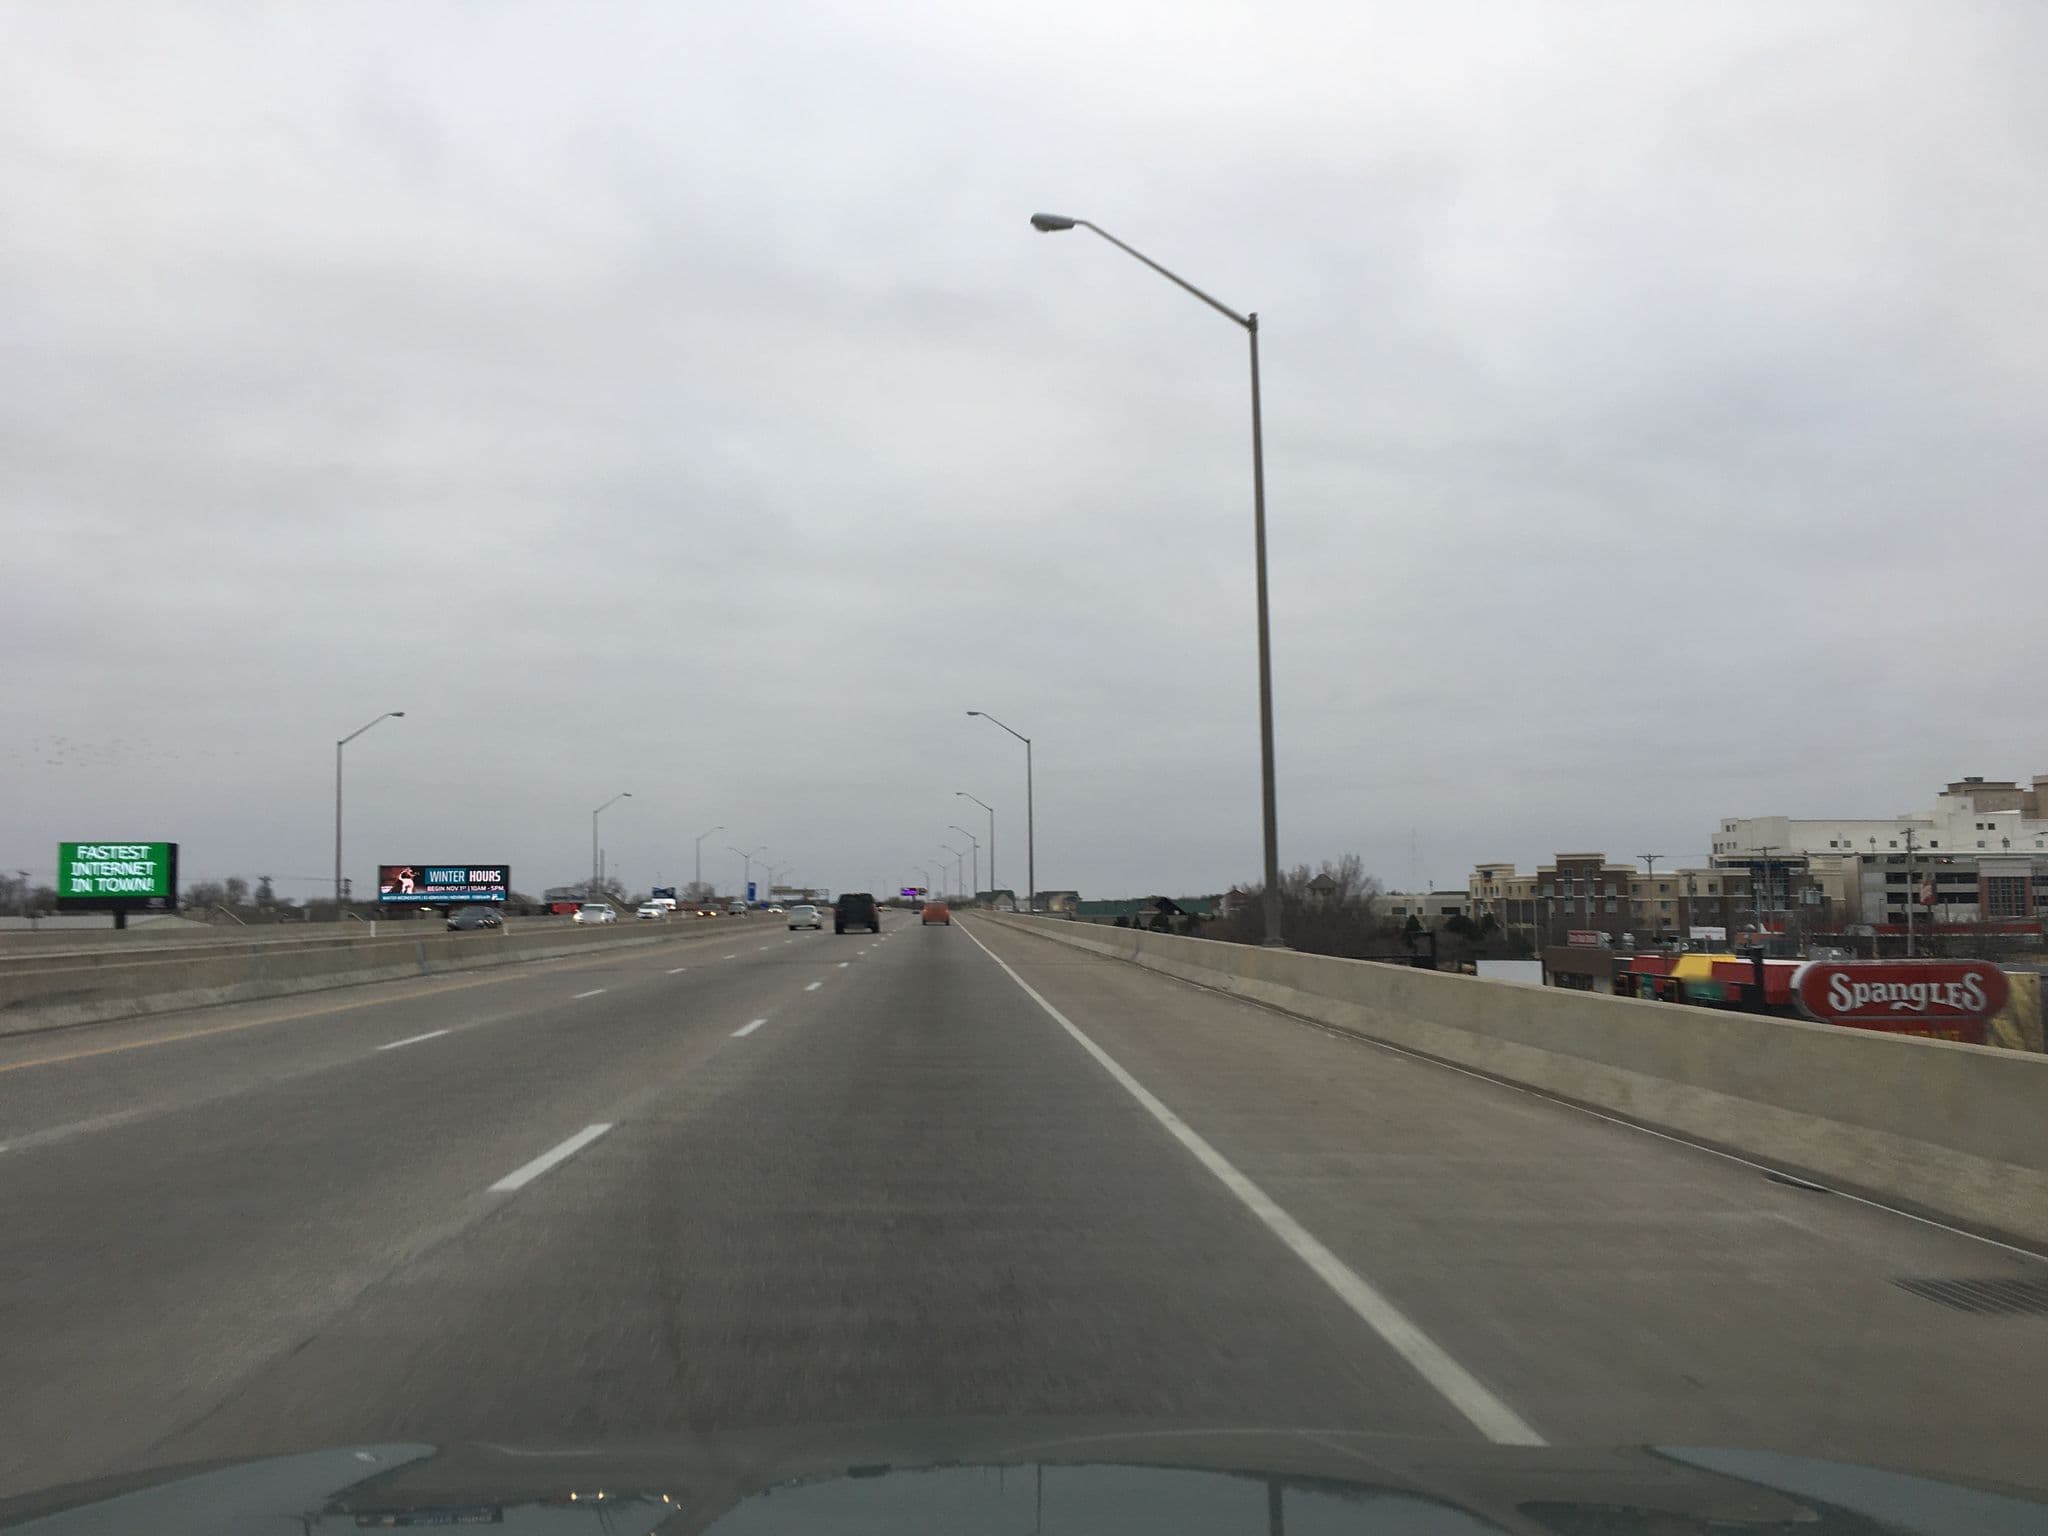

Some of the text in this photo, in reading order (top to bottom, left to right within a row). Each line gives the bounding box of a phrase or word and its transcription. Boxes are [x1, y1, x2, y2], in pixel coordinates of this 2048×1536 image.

[77, 845, 152, 860] FASTEST
[71, 861, 157, 876] INTERNET
[429, 870, 501, 882] WINTER HOURS
[71, 877, 155, 893] IN TOWN!
